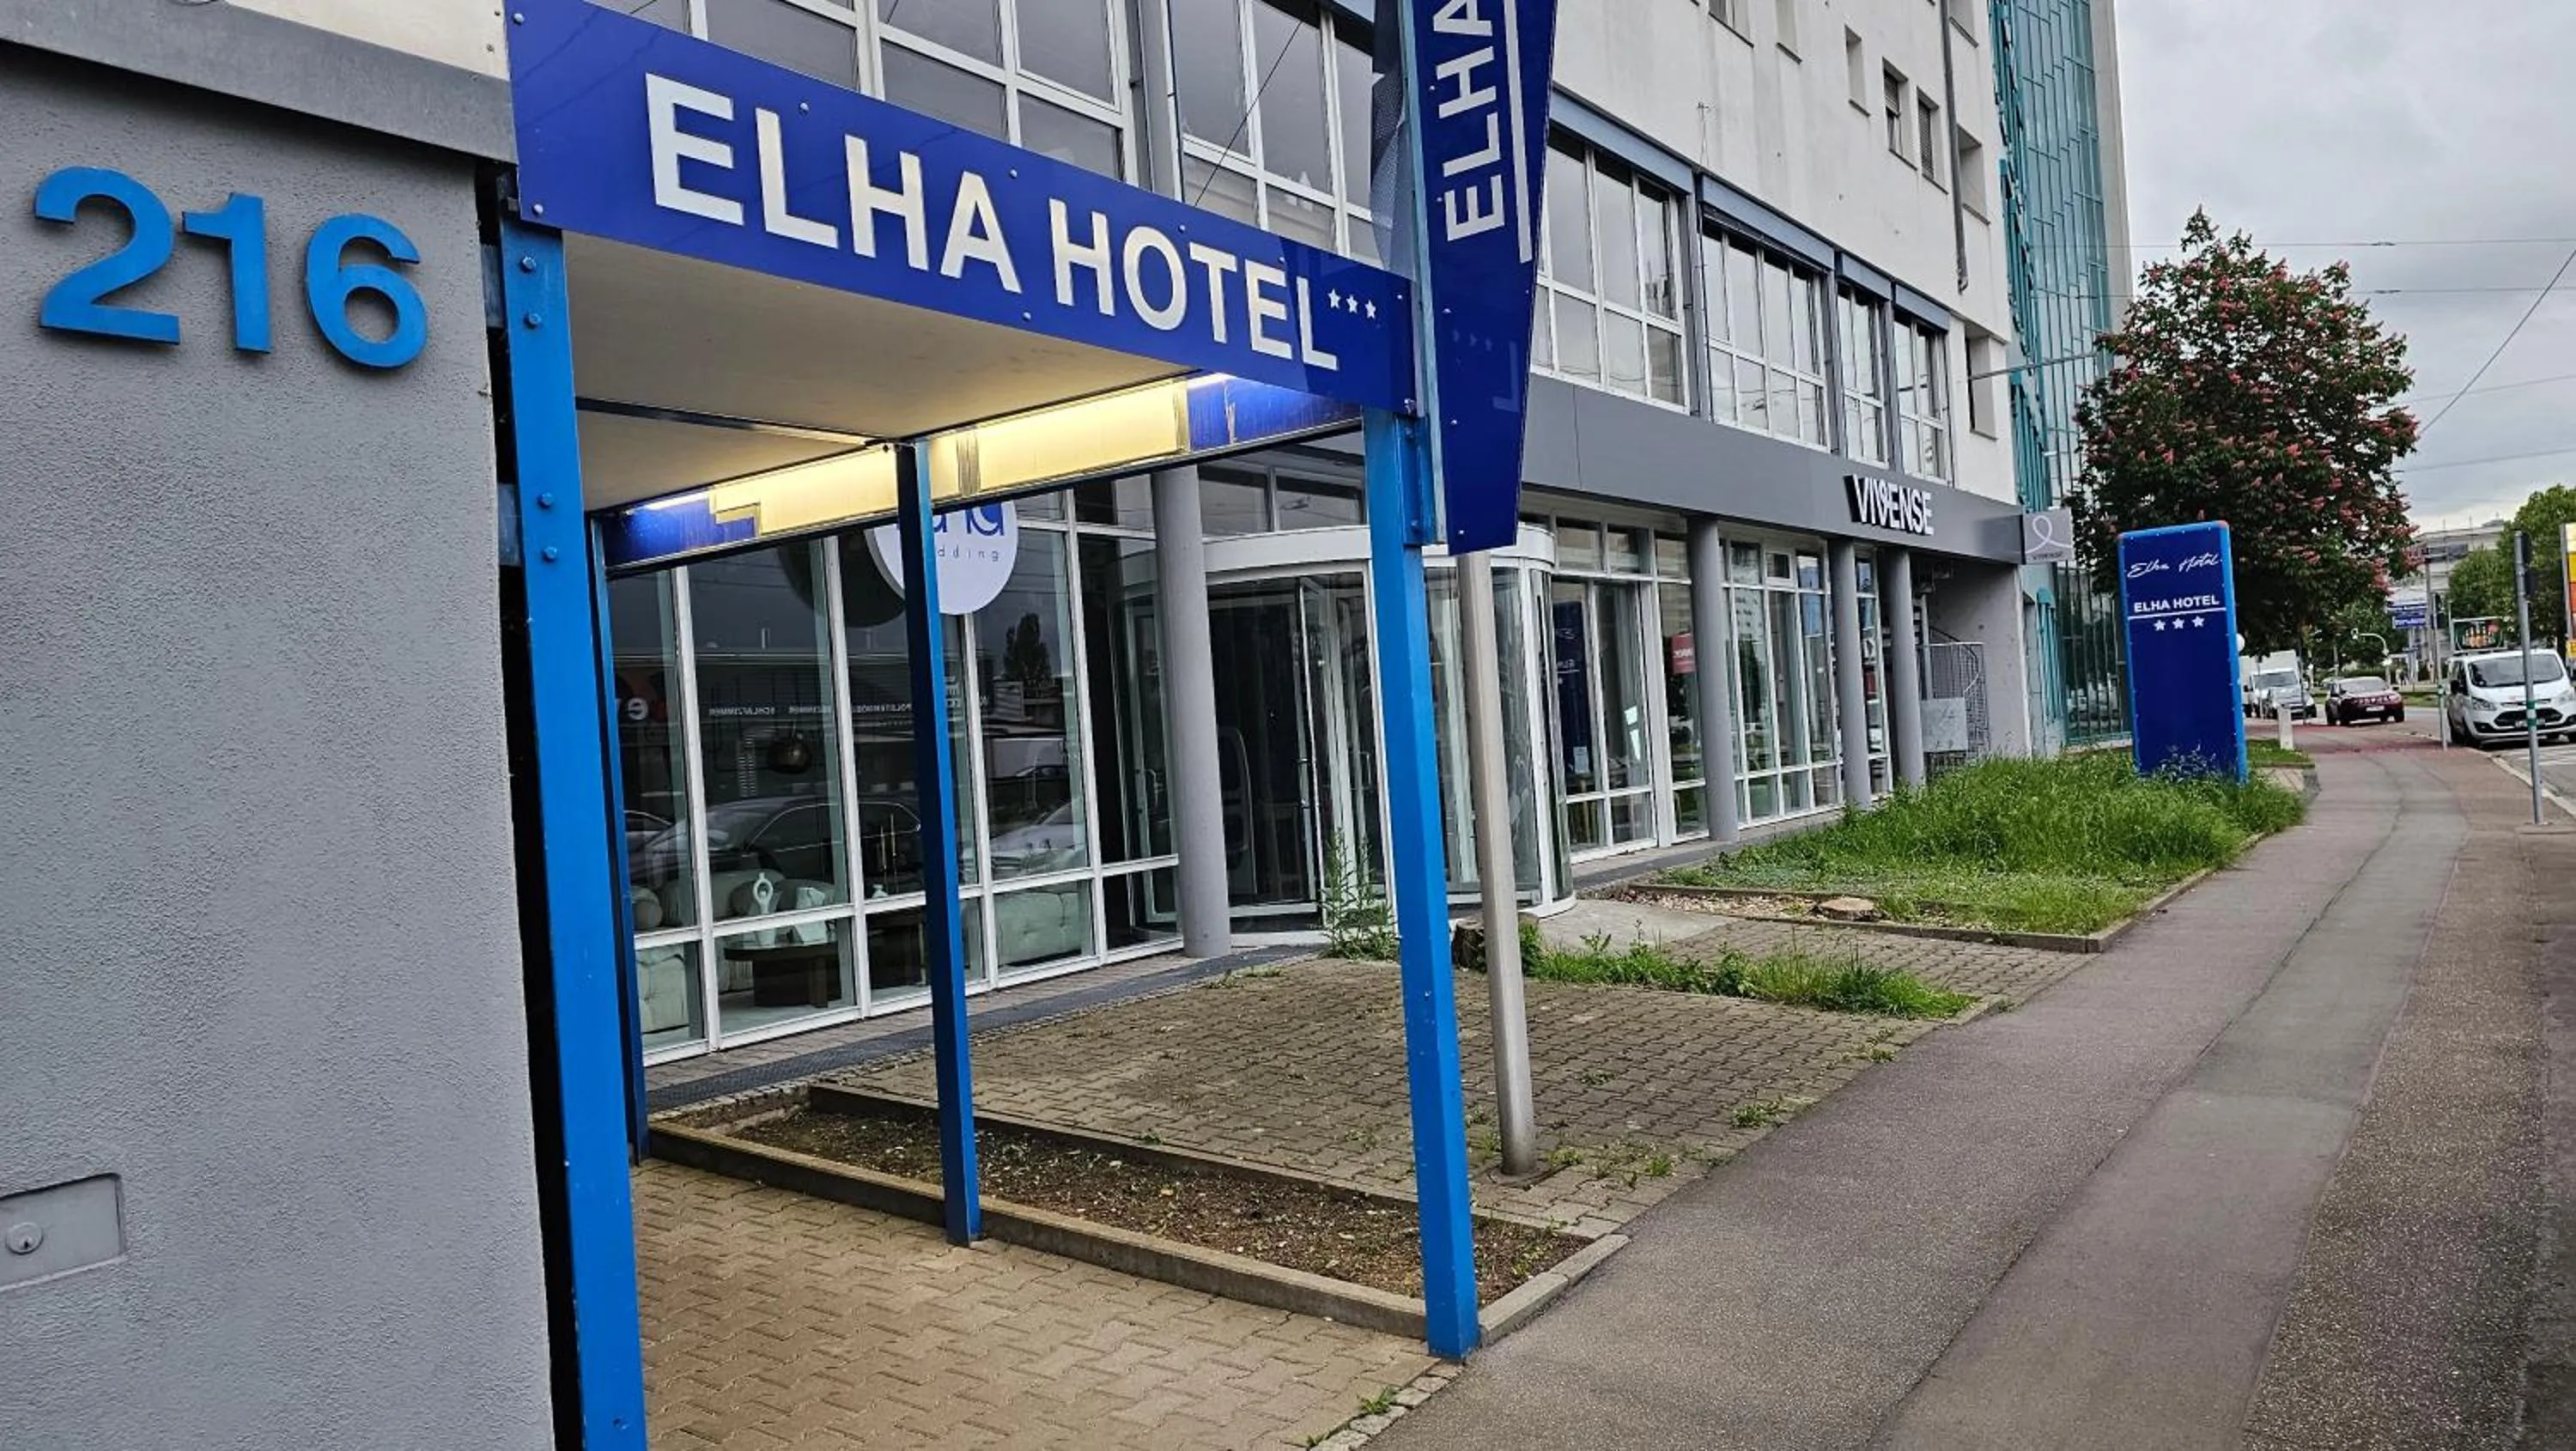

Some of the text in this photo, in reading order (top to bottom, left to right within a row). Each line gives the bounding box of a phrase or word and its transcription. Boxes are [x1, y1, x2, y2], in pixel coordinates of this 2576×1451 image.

[1432, 0, 1506, 241] ELHA
[33, 165, 427, 369] 216
[646, 72, 1340, 370] ELHA HOTEL
[937, 544, 999, 562] dding
[2128, 552, 2220, 578] Elha Hotel
[2134, 594, 2220, 613] ELHA HOTEL
